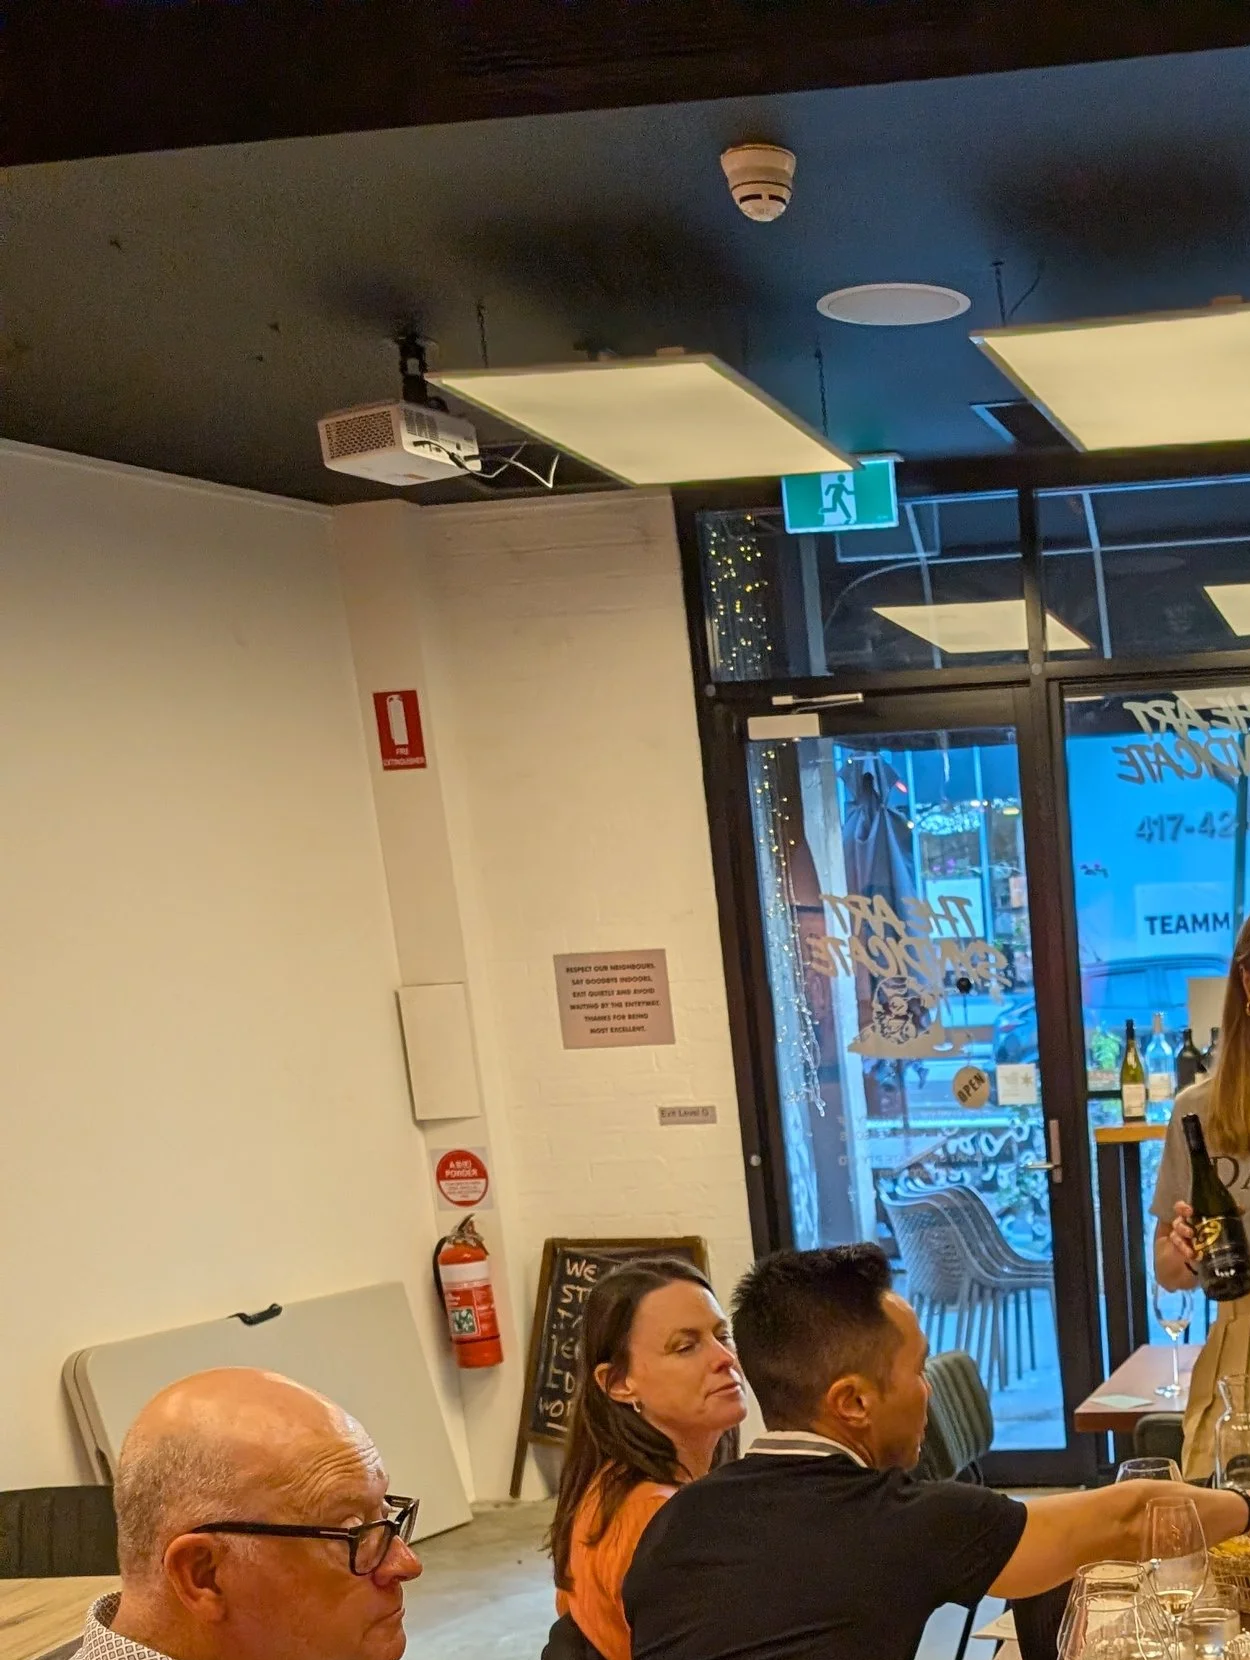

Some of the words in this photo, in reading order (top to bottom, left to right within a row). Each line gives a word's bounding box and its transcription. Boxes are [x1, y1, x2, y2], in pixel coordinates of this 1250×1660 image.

[566, 966, 592, 974] RESPECT
[585, 977, 618, 985] GOODBYE
[957, 1072, 986, 1103] OPEN
